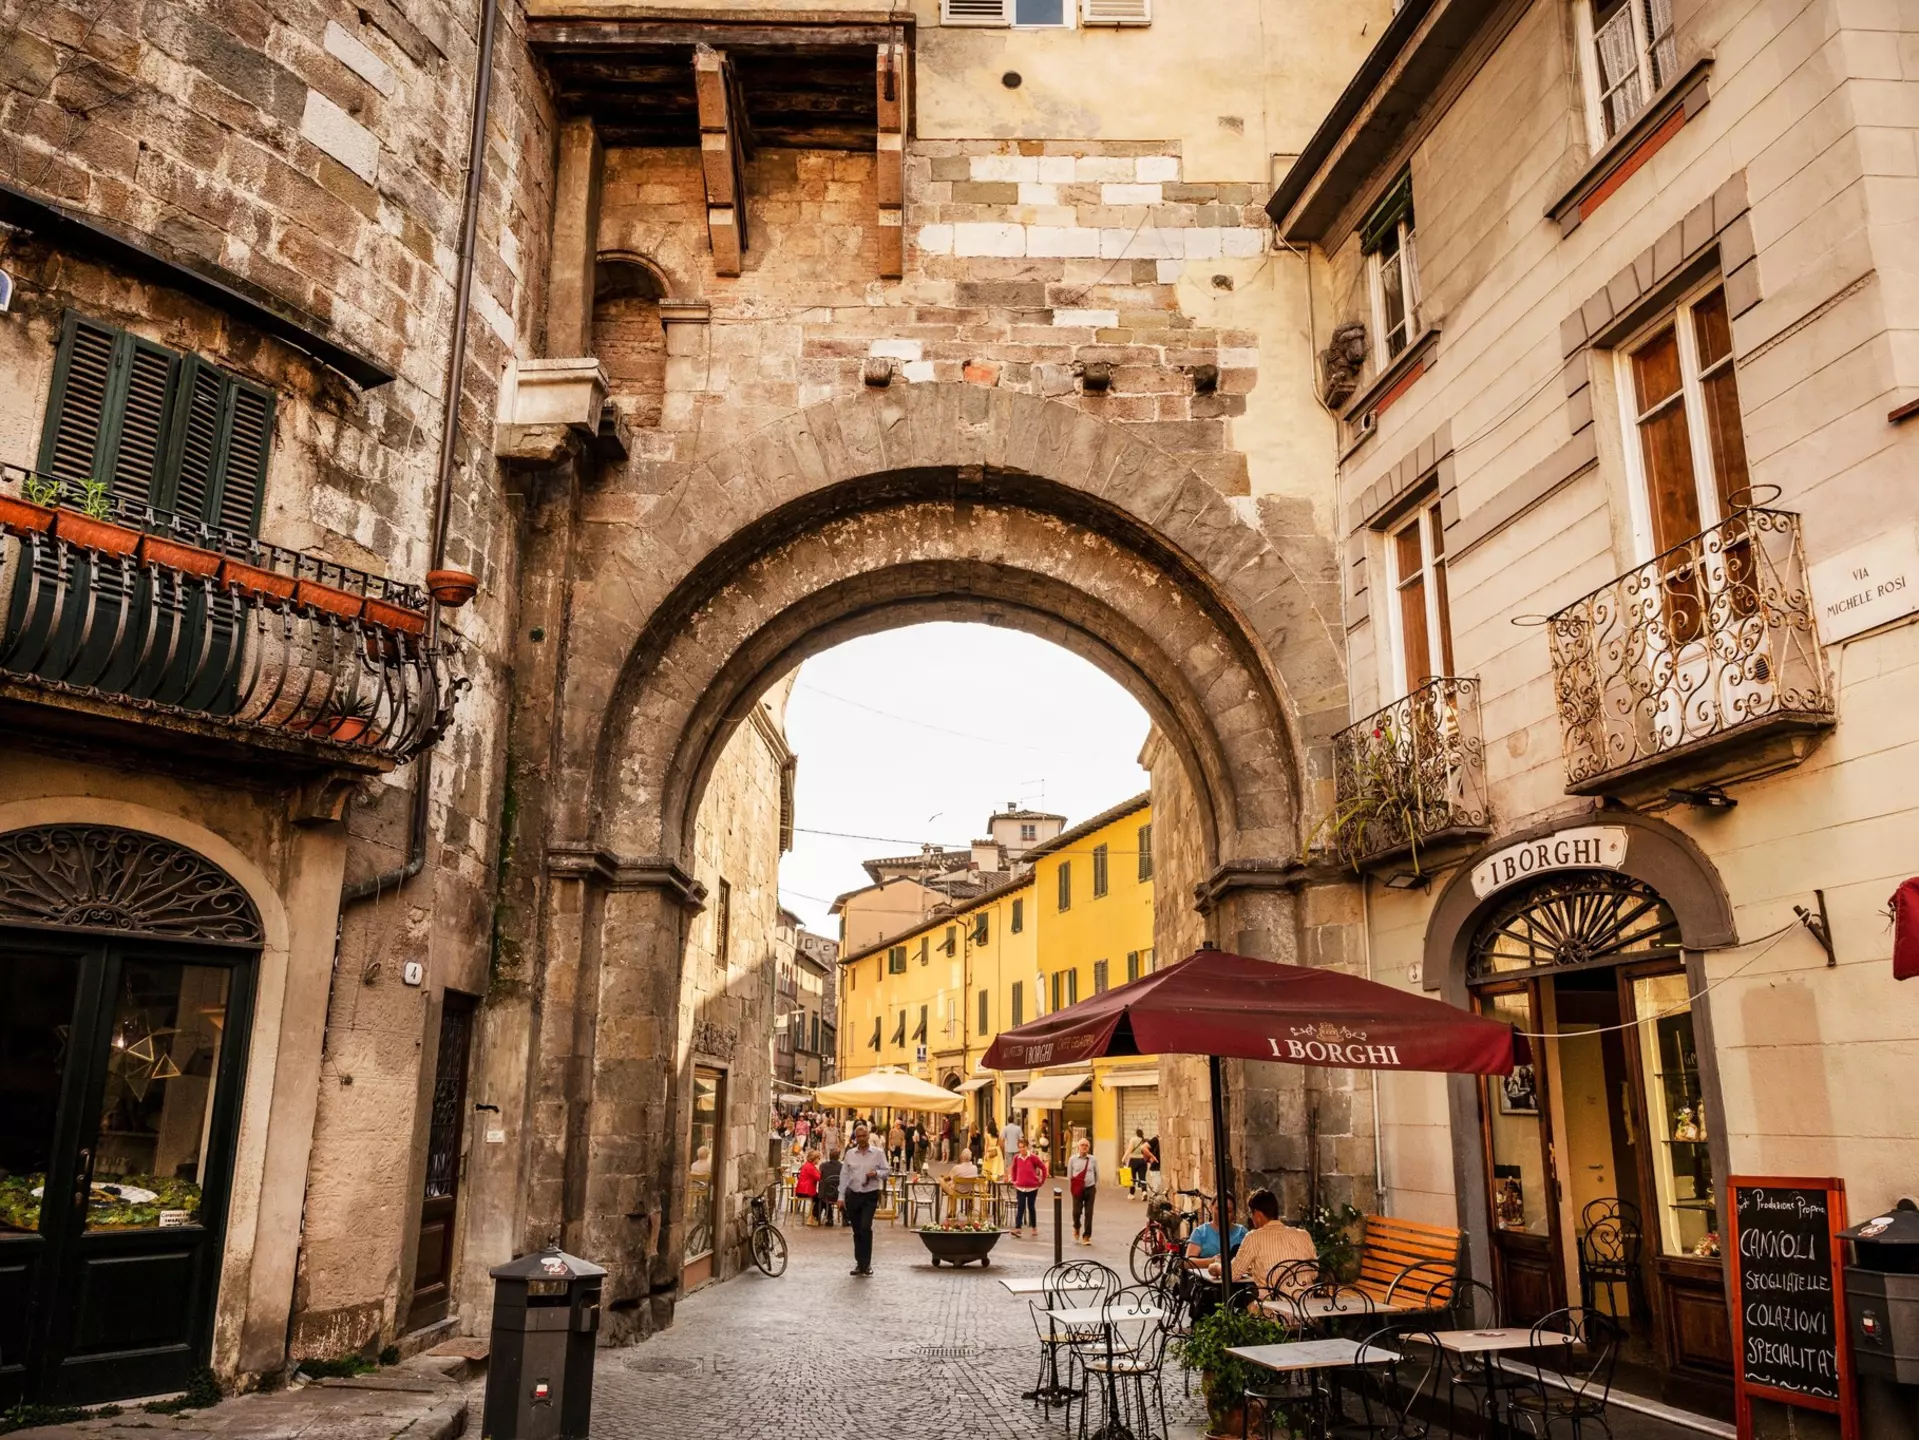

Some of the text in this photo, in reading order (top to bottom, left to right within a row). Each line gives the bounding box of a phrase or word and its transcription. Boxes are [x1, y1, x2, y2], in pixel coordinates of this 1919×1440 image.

[1852, 567, 1869, 580] VIA
[1827, 576, 1906, 618] MICHELE ROSI
[1503, 838, 1602, 881] BORGHI
[1028, 1043, 1054, 1064] BORGHI
[1268, 1038, 1402, 1065] I BORGHI
[1752, 1188, 1795, 1211] Produzione
[1740, 1228, 1816, 1260] CANNOLI
[1746, 1270, 1831, 1293] SFOGLIATELLE
[1746, 1303, 1827, 1335] COLAZIONI
